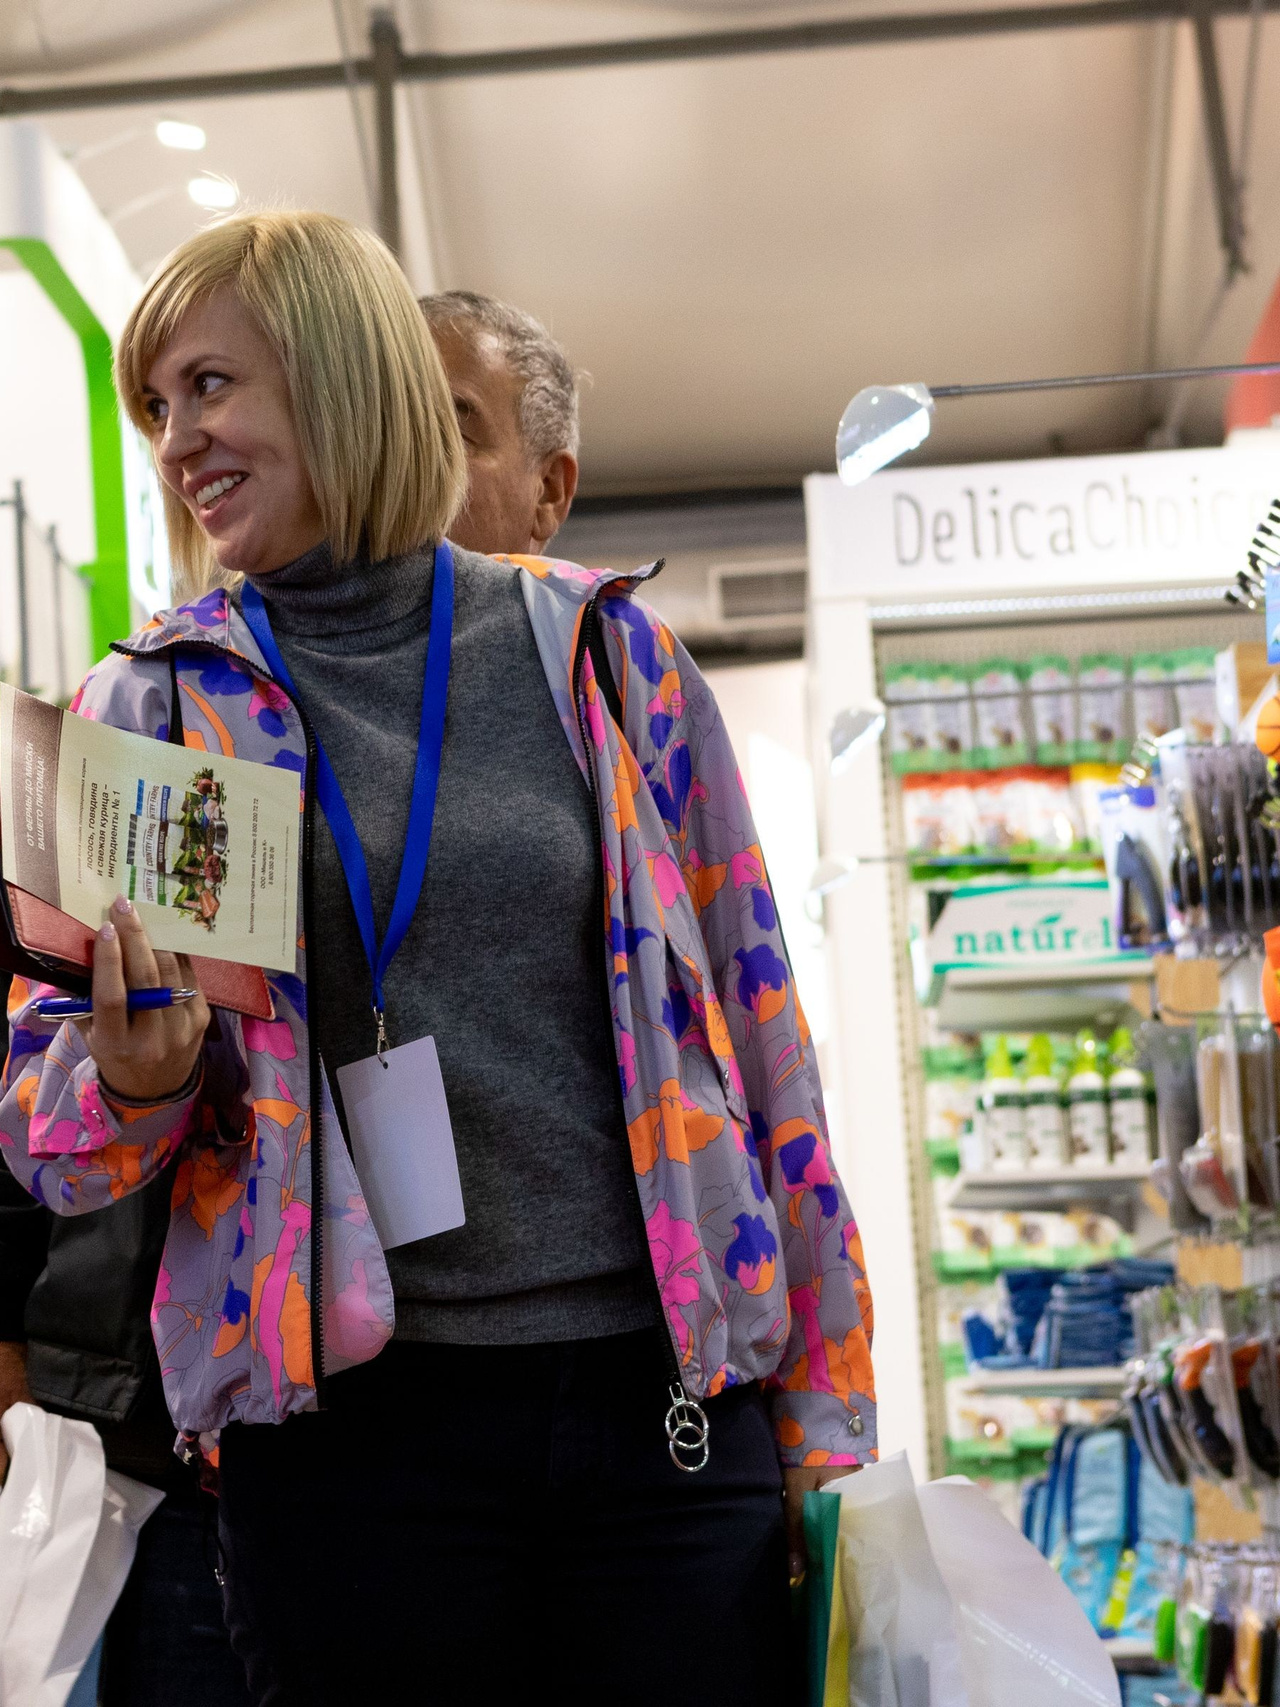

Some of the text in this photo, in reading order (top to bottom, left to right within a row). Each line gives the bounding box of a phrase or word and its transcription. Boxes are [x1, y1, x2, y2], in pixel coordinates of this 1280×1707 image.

[25, 741, 35, 847] ОТ ФЕРМЫ ДО МИСКИ
[36, 756, 45, 851] ВАШЕГО ПИТОМЦА!
[100, 792, 109, 828] курица
[111, 799, 120, 810] №
[150, 785, 159, 803] FARMS
[87, 782, 98, 870] лосось, говядина
[146, 823, 156, 842] FARMS
[97, 830, 106, 868] свежая
[107, 812, 119, 878] ингредиенты
[145, 842, 154, 867] COUNTRY
[145, 878, 154, 902] COUNTRY
